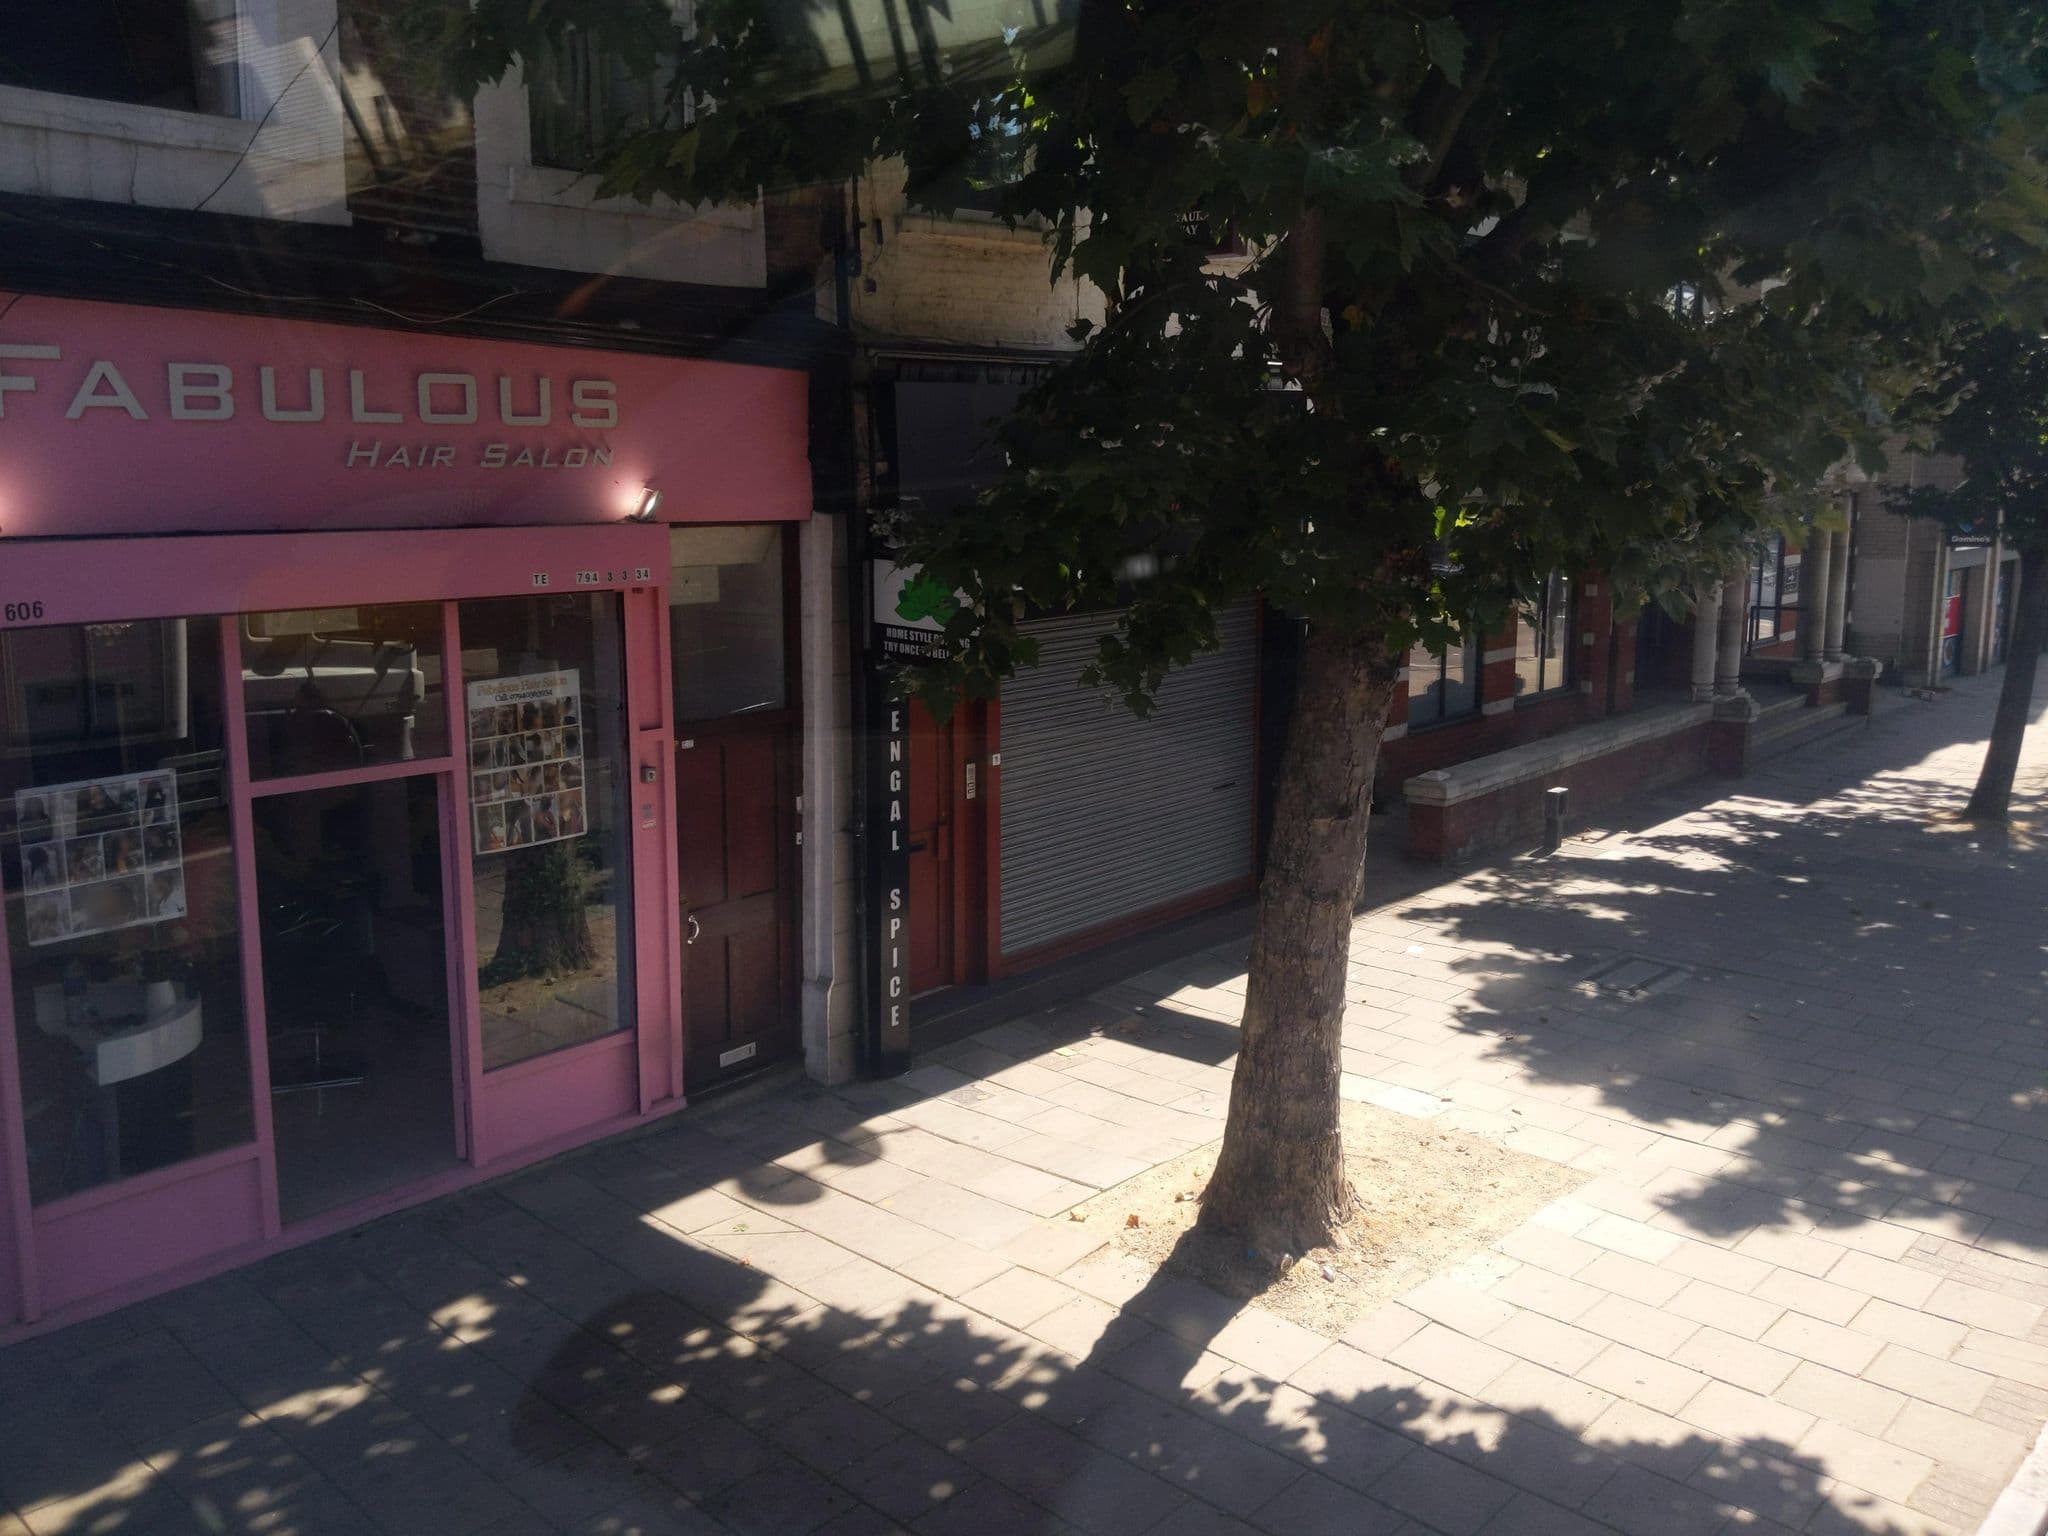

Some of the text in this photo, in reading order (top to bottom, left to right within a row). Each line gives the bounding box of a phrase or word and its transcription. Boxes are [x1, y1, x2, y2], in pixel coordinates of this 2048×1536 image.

[0, 345, 620, 429] FABULOUS
[346, 441, 614, 468] HAIR SALON
[1951, 535, 1991, 543] Domino's
[534, 574, 547, 585] TE
[577, 572, 598, 583] 794
[5, 601, 43, 621] 606
[886, 627, 909, 640] HOME
[910, 630, 932, 644] STYLE
[899, 643, 919, 656] ONCE
[889, 680, 901, 1028] ENGAL SPICE
